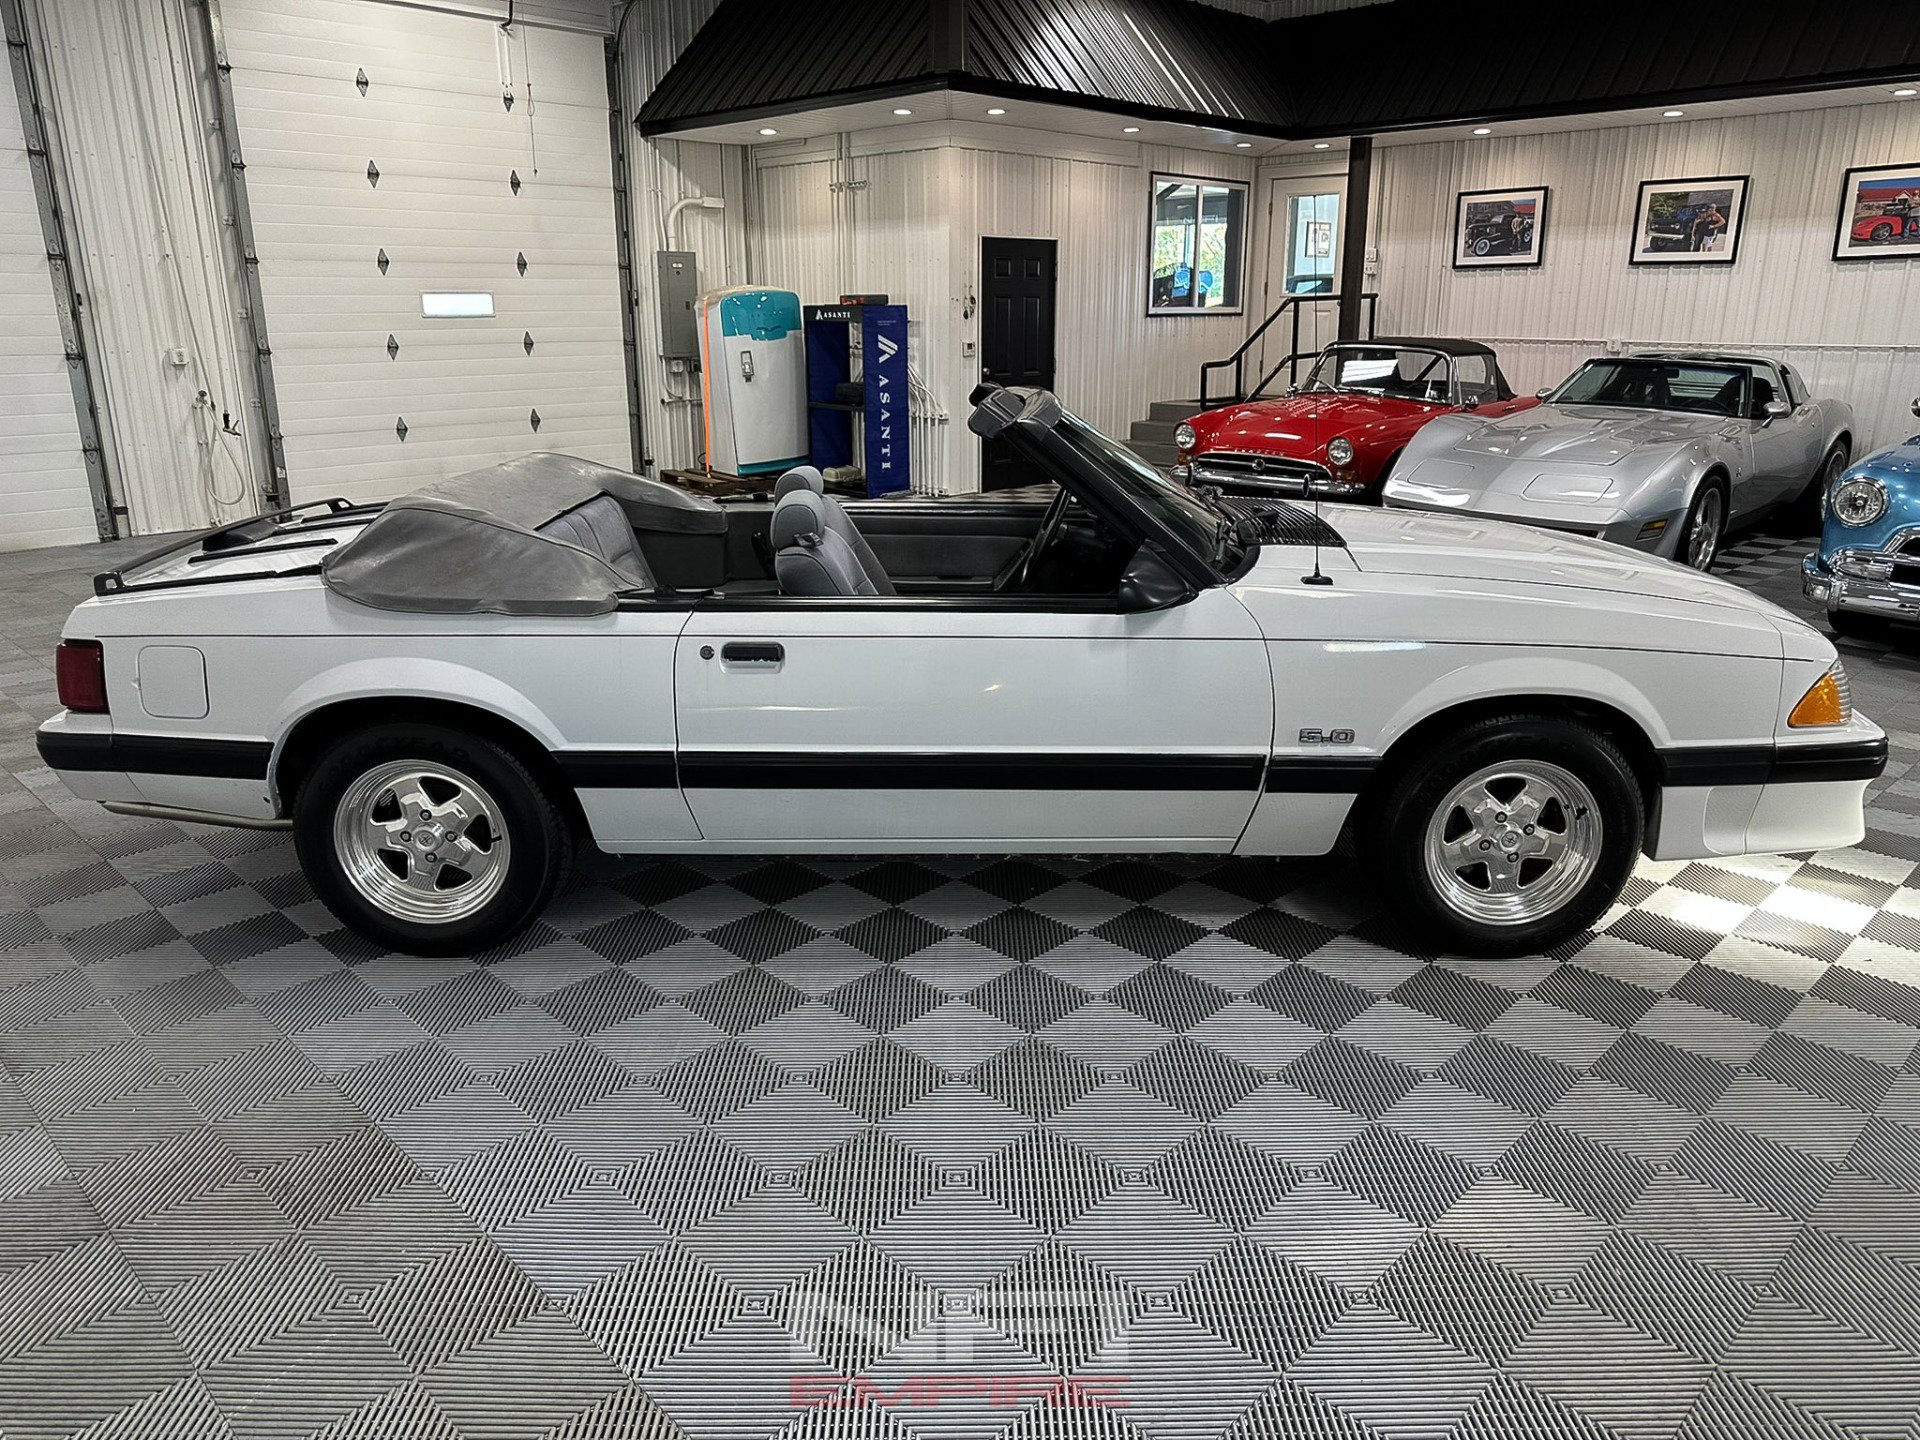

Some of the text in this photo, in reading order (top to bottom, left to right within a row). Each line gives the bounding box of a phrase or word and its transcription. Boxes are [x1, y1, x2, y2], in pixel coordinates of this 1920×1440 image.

[823, 311, 851, 319] ASANTI
[878, 374, 892, 469] ASANTI
[1299, 728, 1355, 743] 5.0
